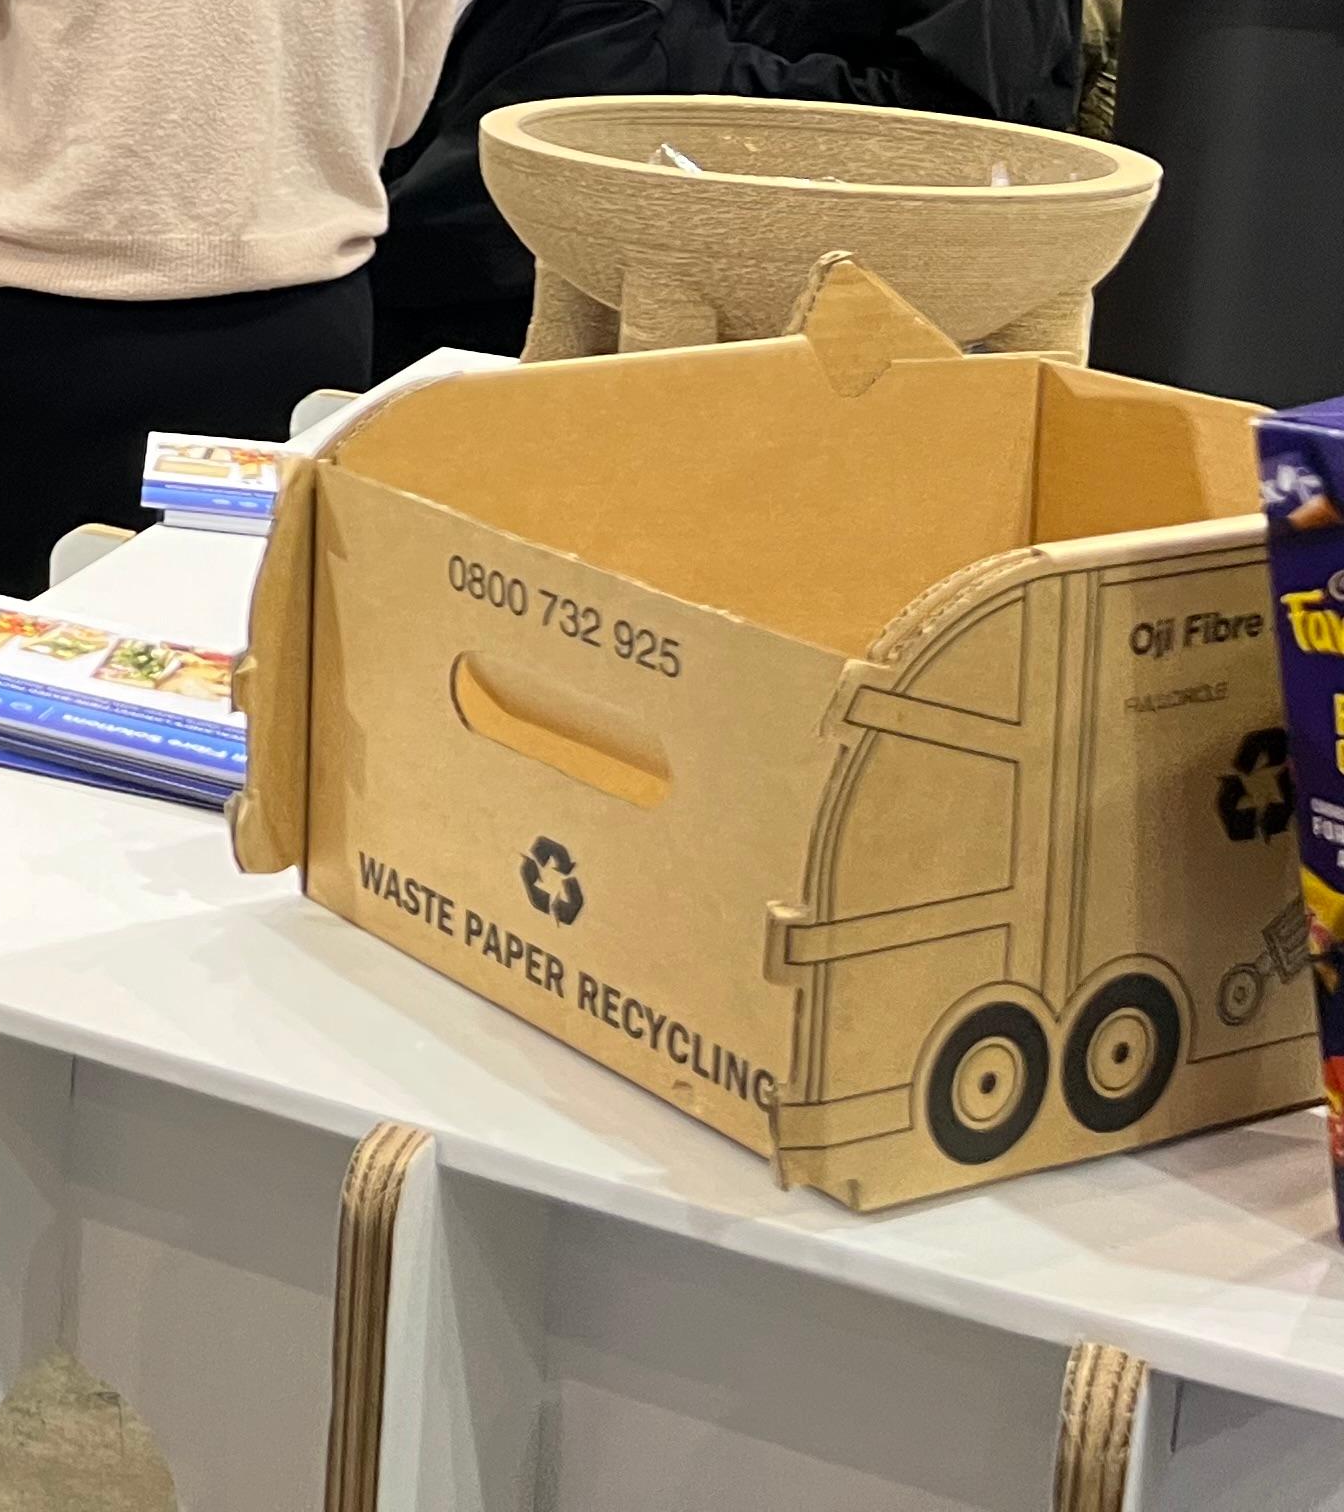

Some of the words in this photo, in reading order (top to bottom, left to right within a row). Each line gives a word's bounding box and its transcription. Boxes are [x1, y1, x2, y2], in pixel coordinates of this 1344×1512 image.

[448, 554, 529, 616] 0800
[538, 589, 602, 648] 732
[613, 620, 681, 678] 925
[1183, 611, 1264, 648] Fibre
[358, 851, 456, 936] WASTE
[464, 909, 565, 998] PAPER
